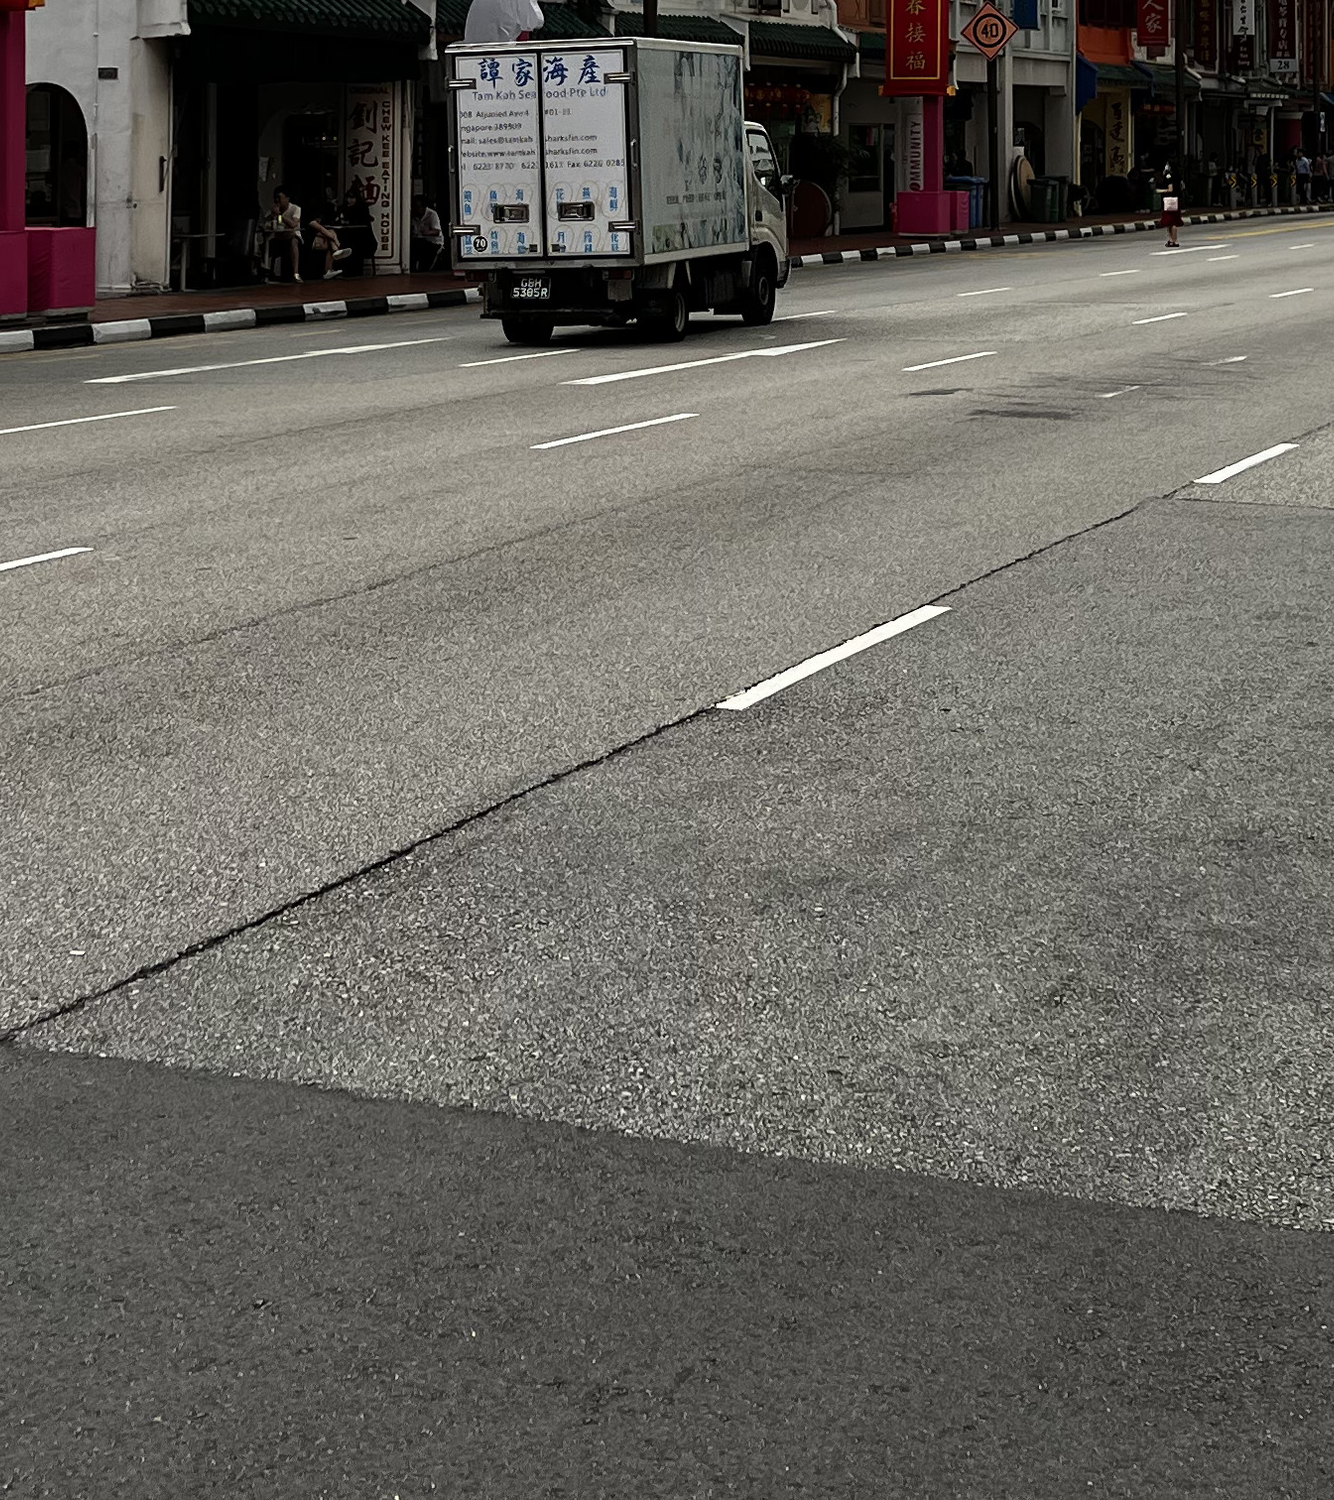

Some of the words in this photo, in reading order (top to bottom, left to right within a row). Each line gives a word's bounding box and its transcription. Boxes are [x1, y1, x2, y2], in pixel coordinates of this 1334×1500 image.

[981, 23, 999, 39] 40
[478, 54, 601, 88] 譚家海產
[1277, 60, 1290, 70] 28
[472, 91, 494, 101] Tam
[496, 90, 516, 100] Kah
[569, 87, 587, 99] Pte
[589, 86, 607, 98] Ltd
[381, 101, 392, 131] CHEW
[382, 135, 390, 158] KEE
[909, 121, 921, 192] OMMUNITY
[381, 162, 390, 208] EATING
[381, 213, 390, 251] HOUSE
[475, 238, 487, 248] 70
[520, 278, 542, 288] GBH
